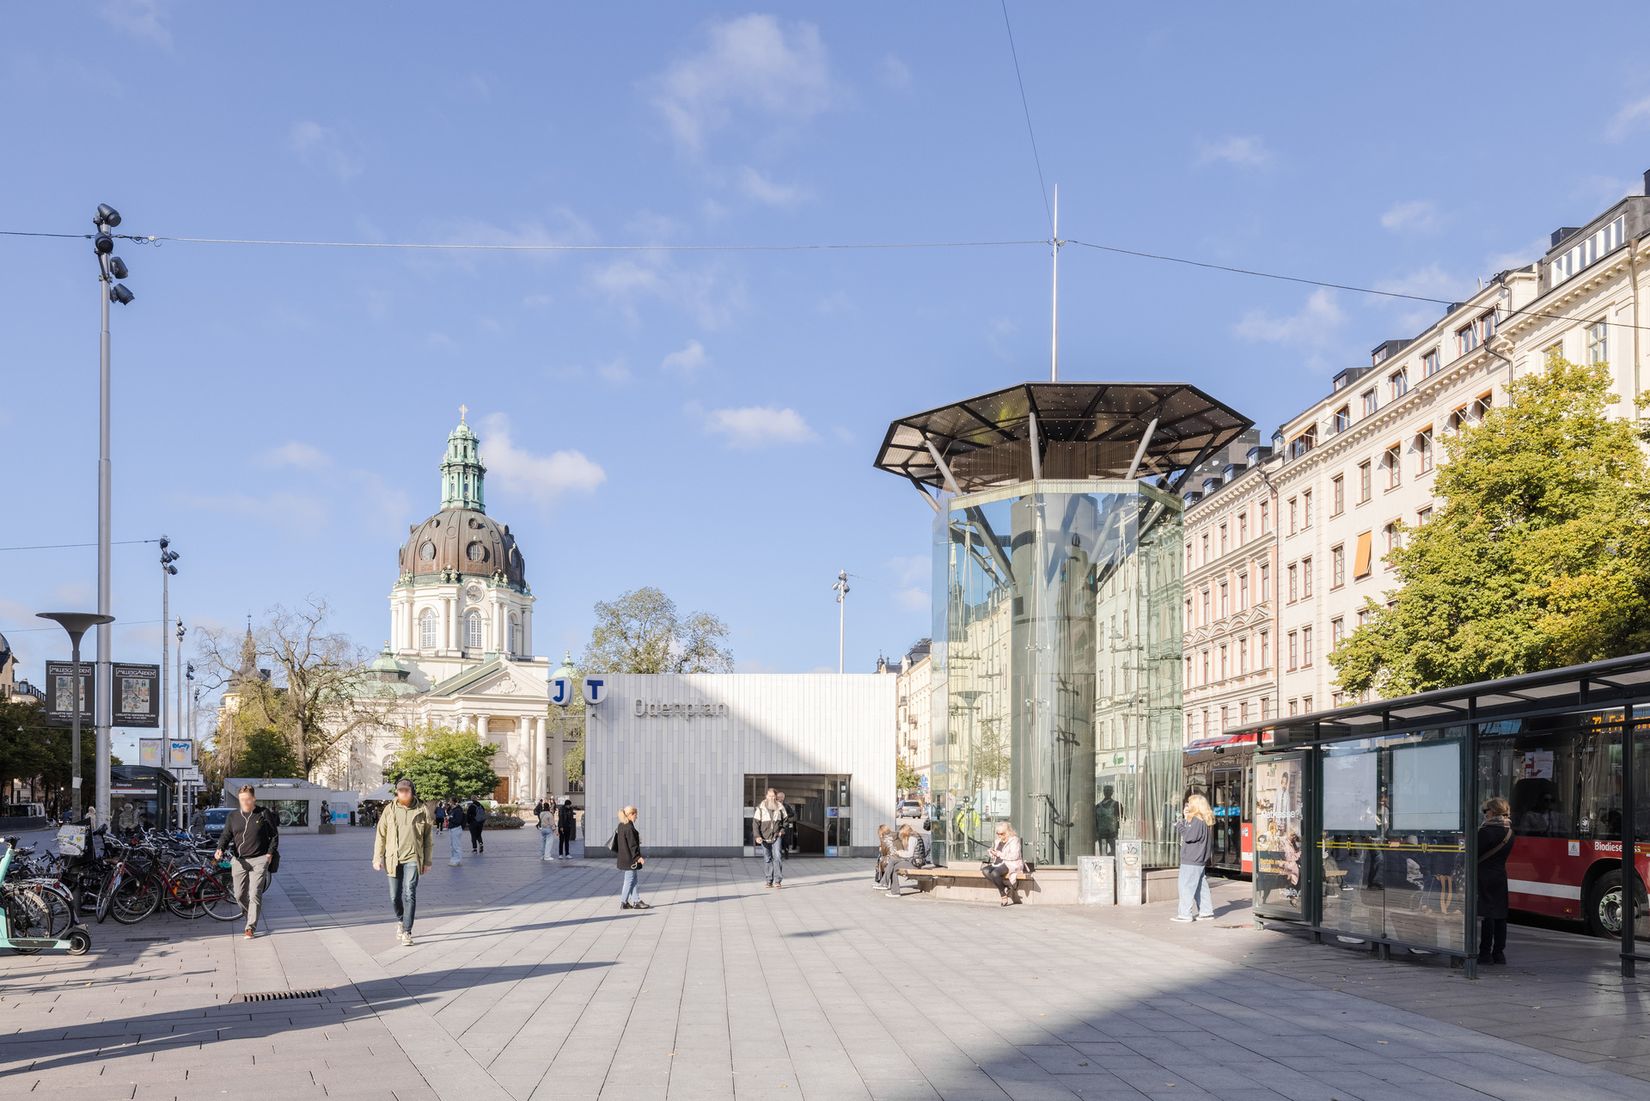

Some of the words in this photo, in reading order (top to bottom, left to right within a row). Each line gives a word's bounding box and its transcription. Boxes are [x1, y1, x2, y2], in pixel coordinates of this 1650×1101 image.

[553, 680, 564, 702] J
[587, 680, 604, 699] T
[634, 699, 729, 722] Odenplan
